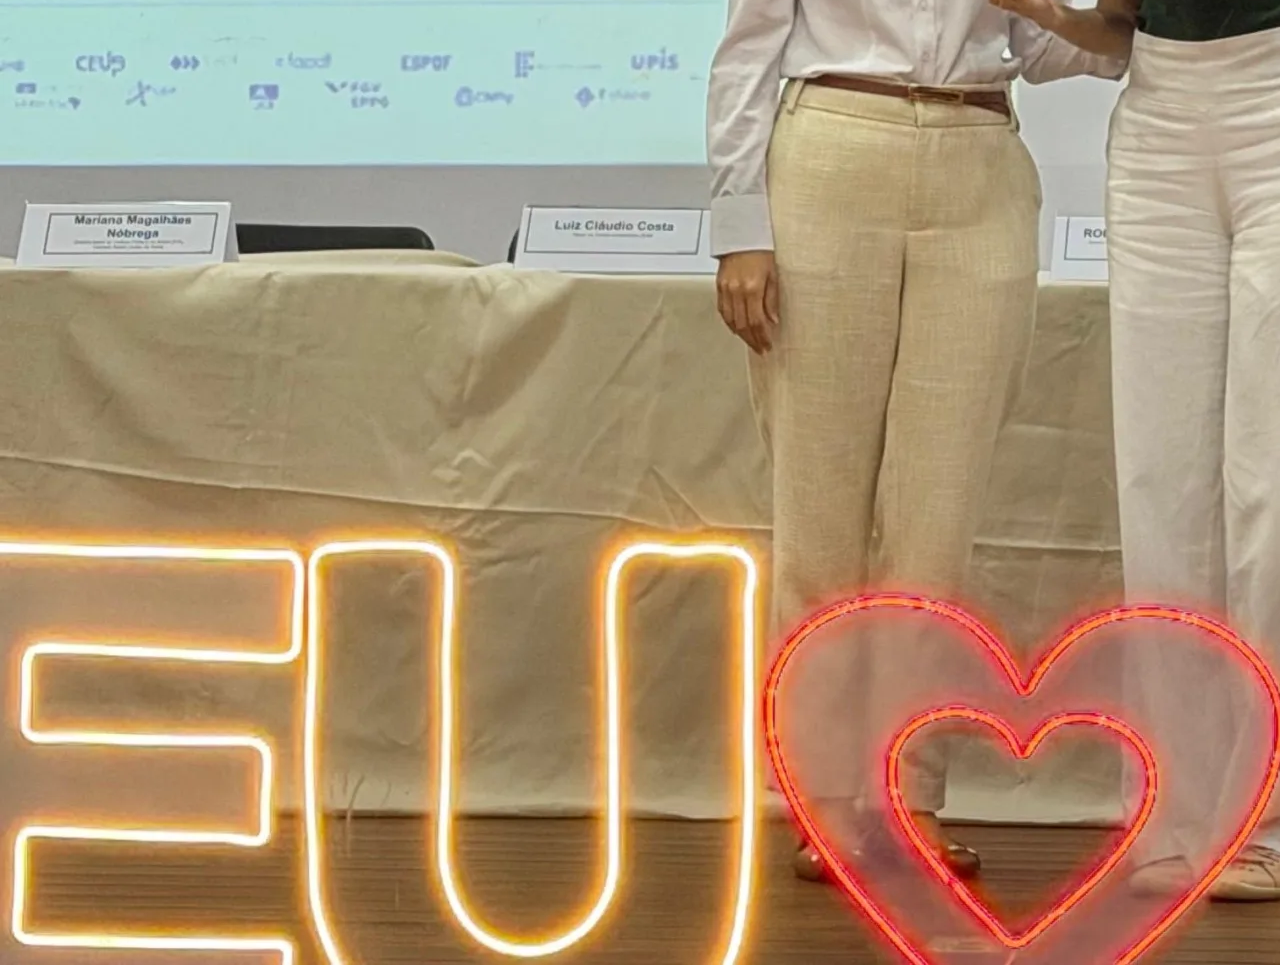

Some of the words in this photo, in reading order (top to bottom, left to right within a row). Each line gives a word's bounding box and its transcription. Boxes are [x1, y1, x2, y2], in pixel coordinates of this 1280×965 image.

[74, 214, 123, 225] Mariana
[126, 214, 192, 226] Magalhães
[554, 220, 581, 231] Luiz
[585, 220, 634, 231] Cláudio
[637, 220, 675, 232] Costa
[106, 228, 160, 240] Nóbrega
[1083, 227, 1107, 239] RO
